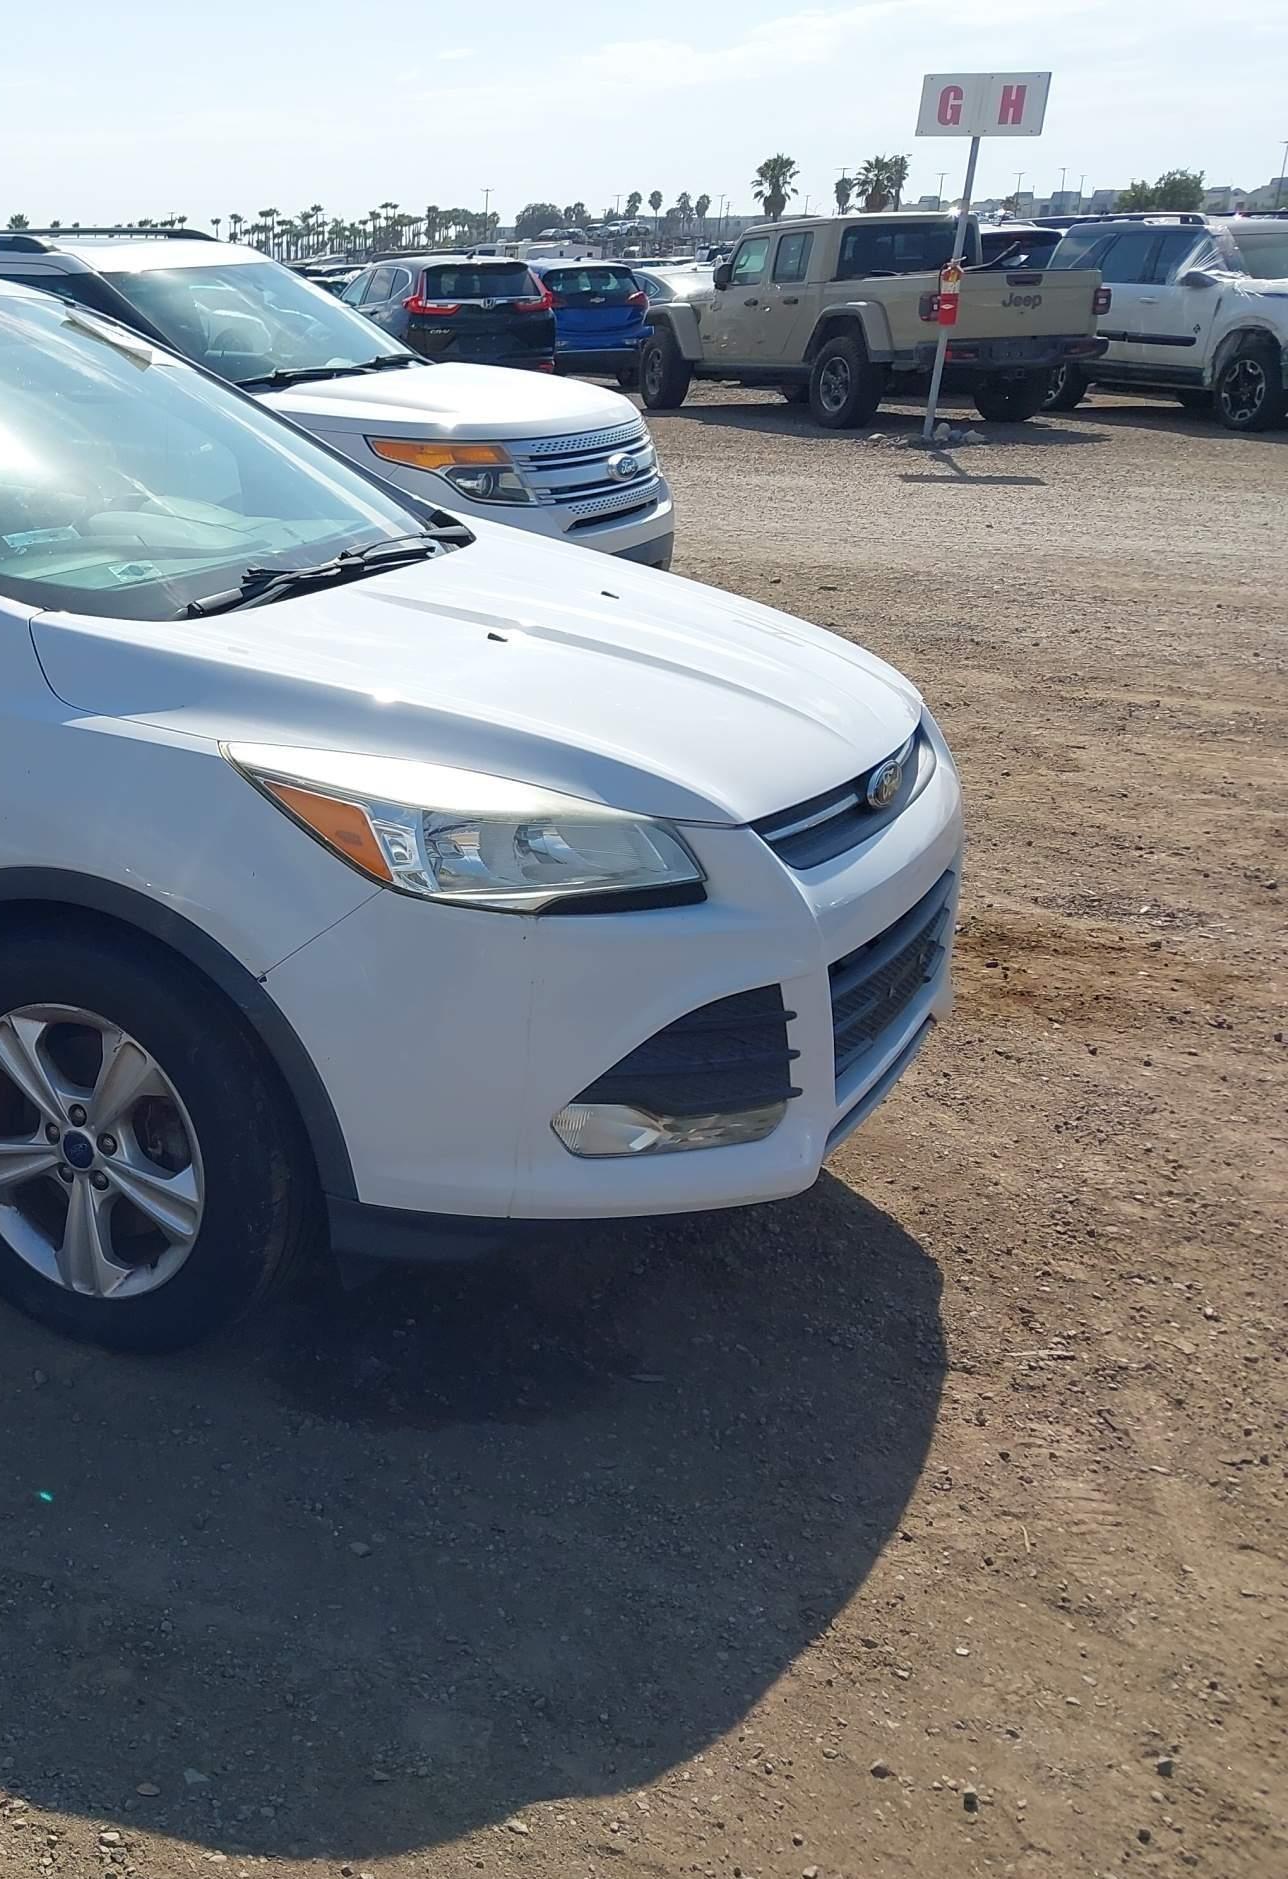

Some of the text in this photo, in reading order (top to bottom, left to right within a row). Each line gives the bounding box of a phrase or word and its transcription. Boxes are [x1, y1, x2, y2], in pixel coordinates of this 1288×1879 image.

[937, 85, 1027, 126] G H
[1002, 292, 1042, 309] Jeep
